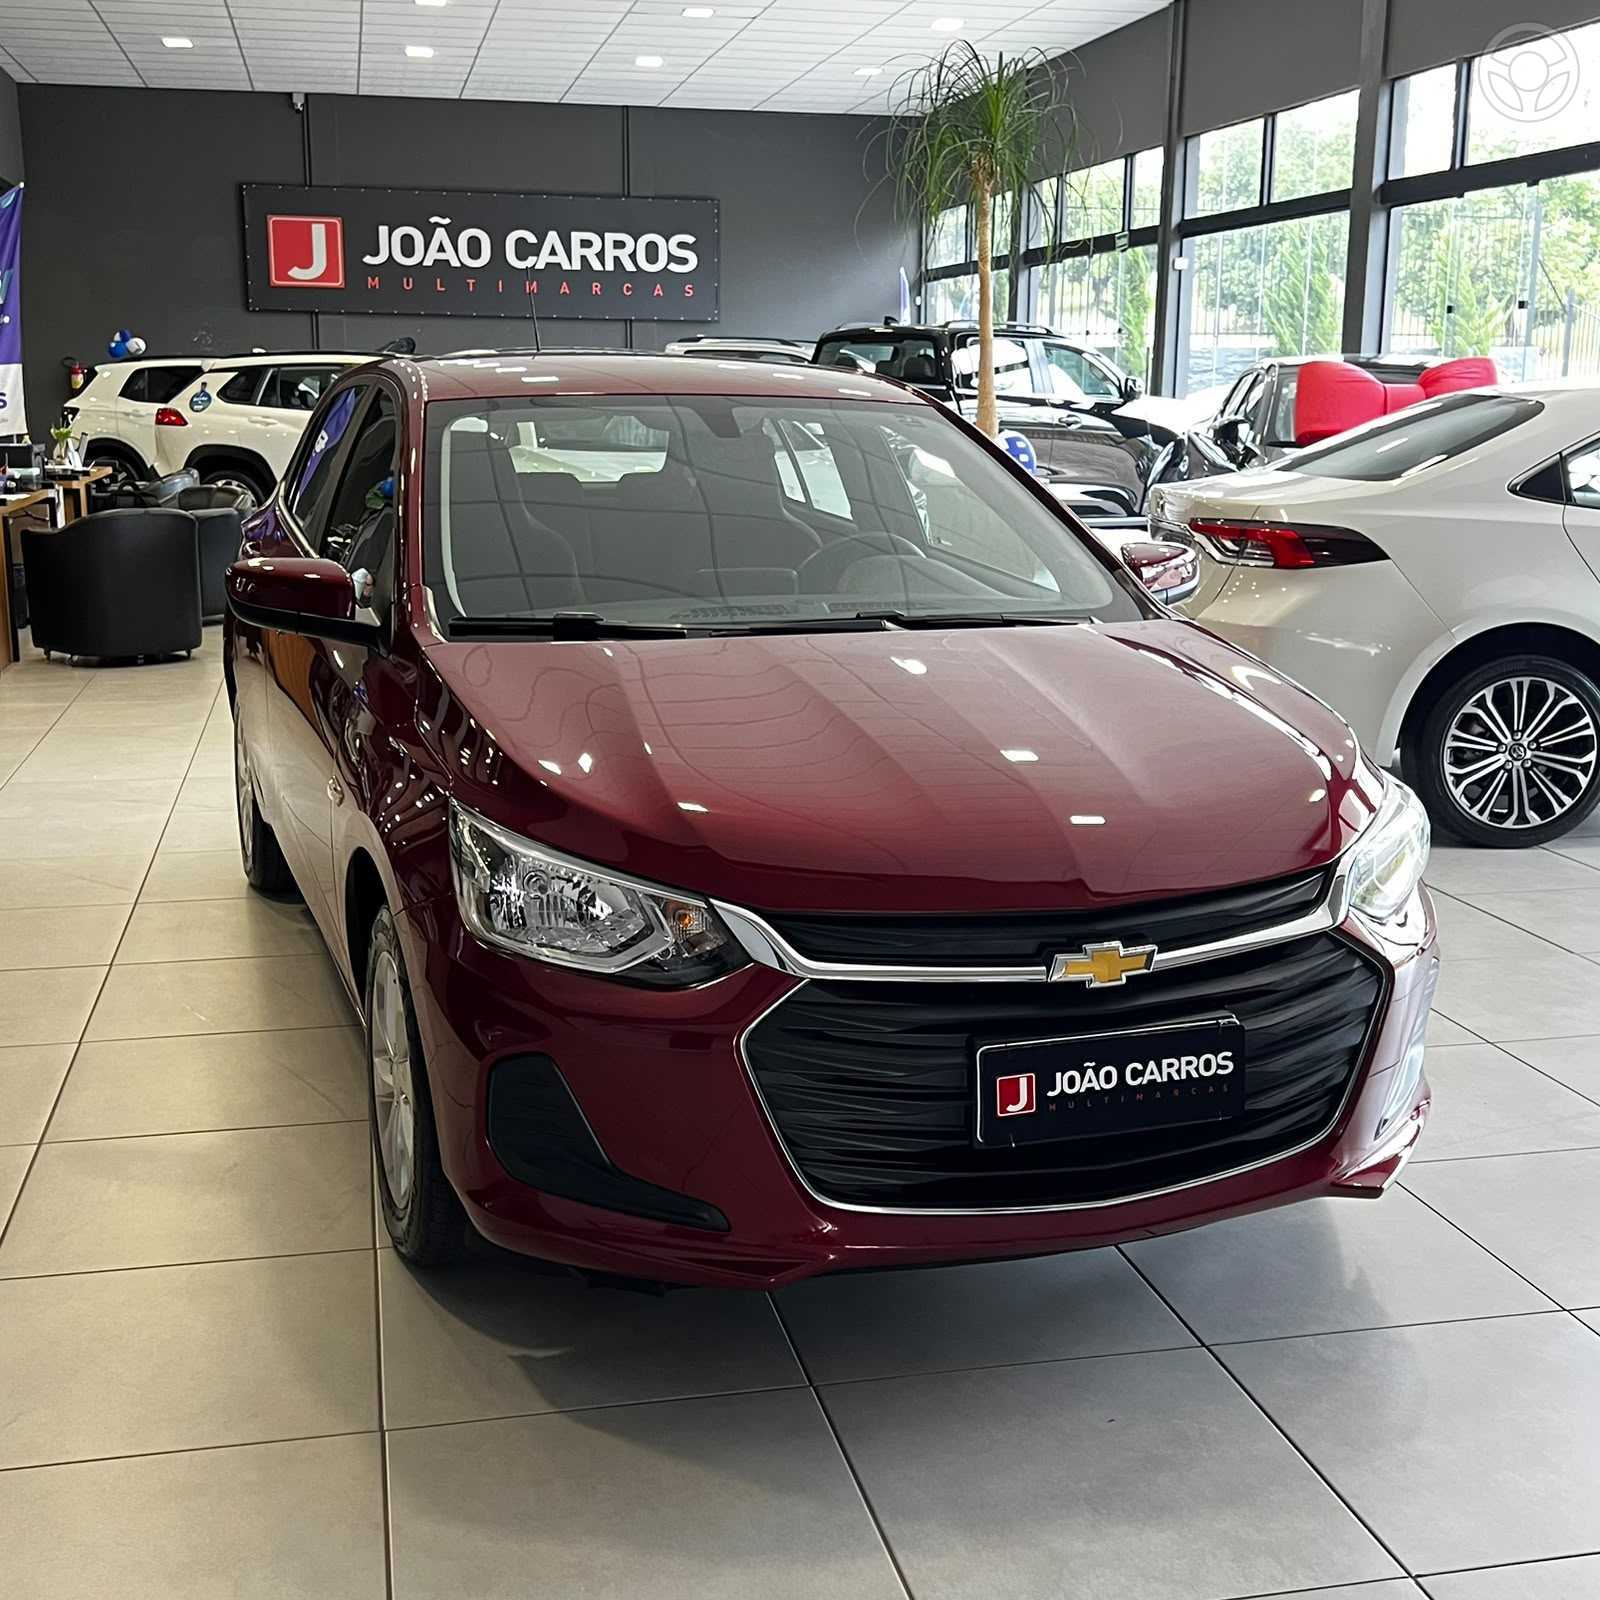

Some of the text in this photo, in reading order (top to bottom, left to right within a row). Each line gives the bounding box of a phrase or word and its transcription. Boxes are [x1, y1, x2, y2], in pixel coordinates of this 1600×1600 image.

[287, 223, 327, 280] J
[362, 215, 699, 274] JOÃO CARROS
[367, 277, 695, 297] MULTIMARCAS
[1006, 1076, 1028, 1112] J
[1046, 1051, 1234, 1097] JOÃO CARROS
[1048, 1084, 1230, 1112] MULTIMARCAS
